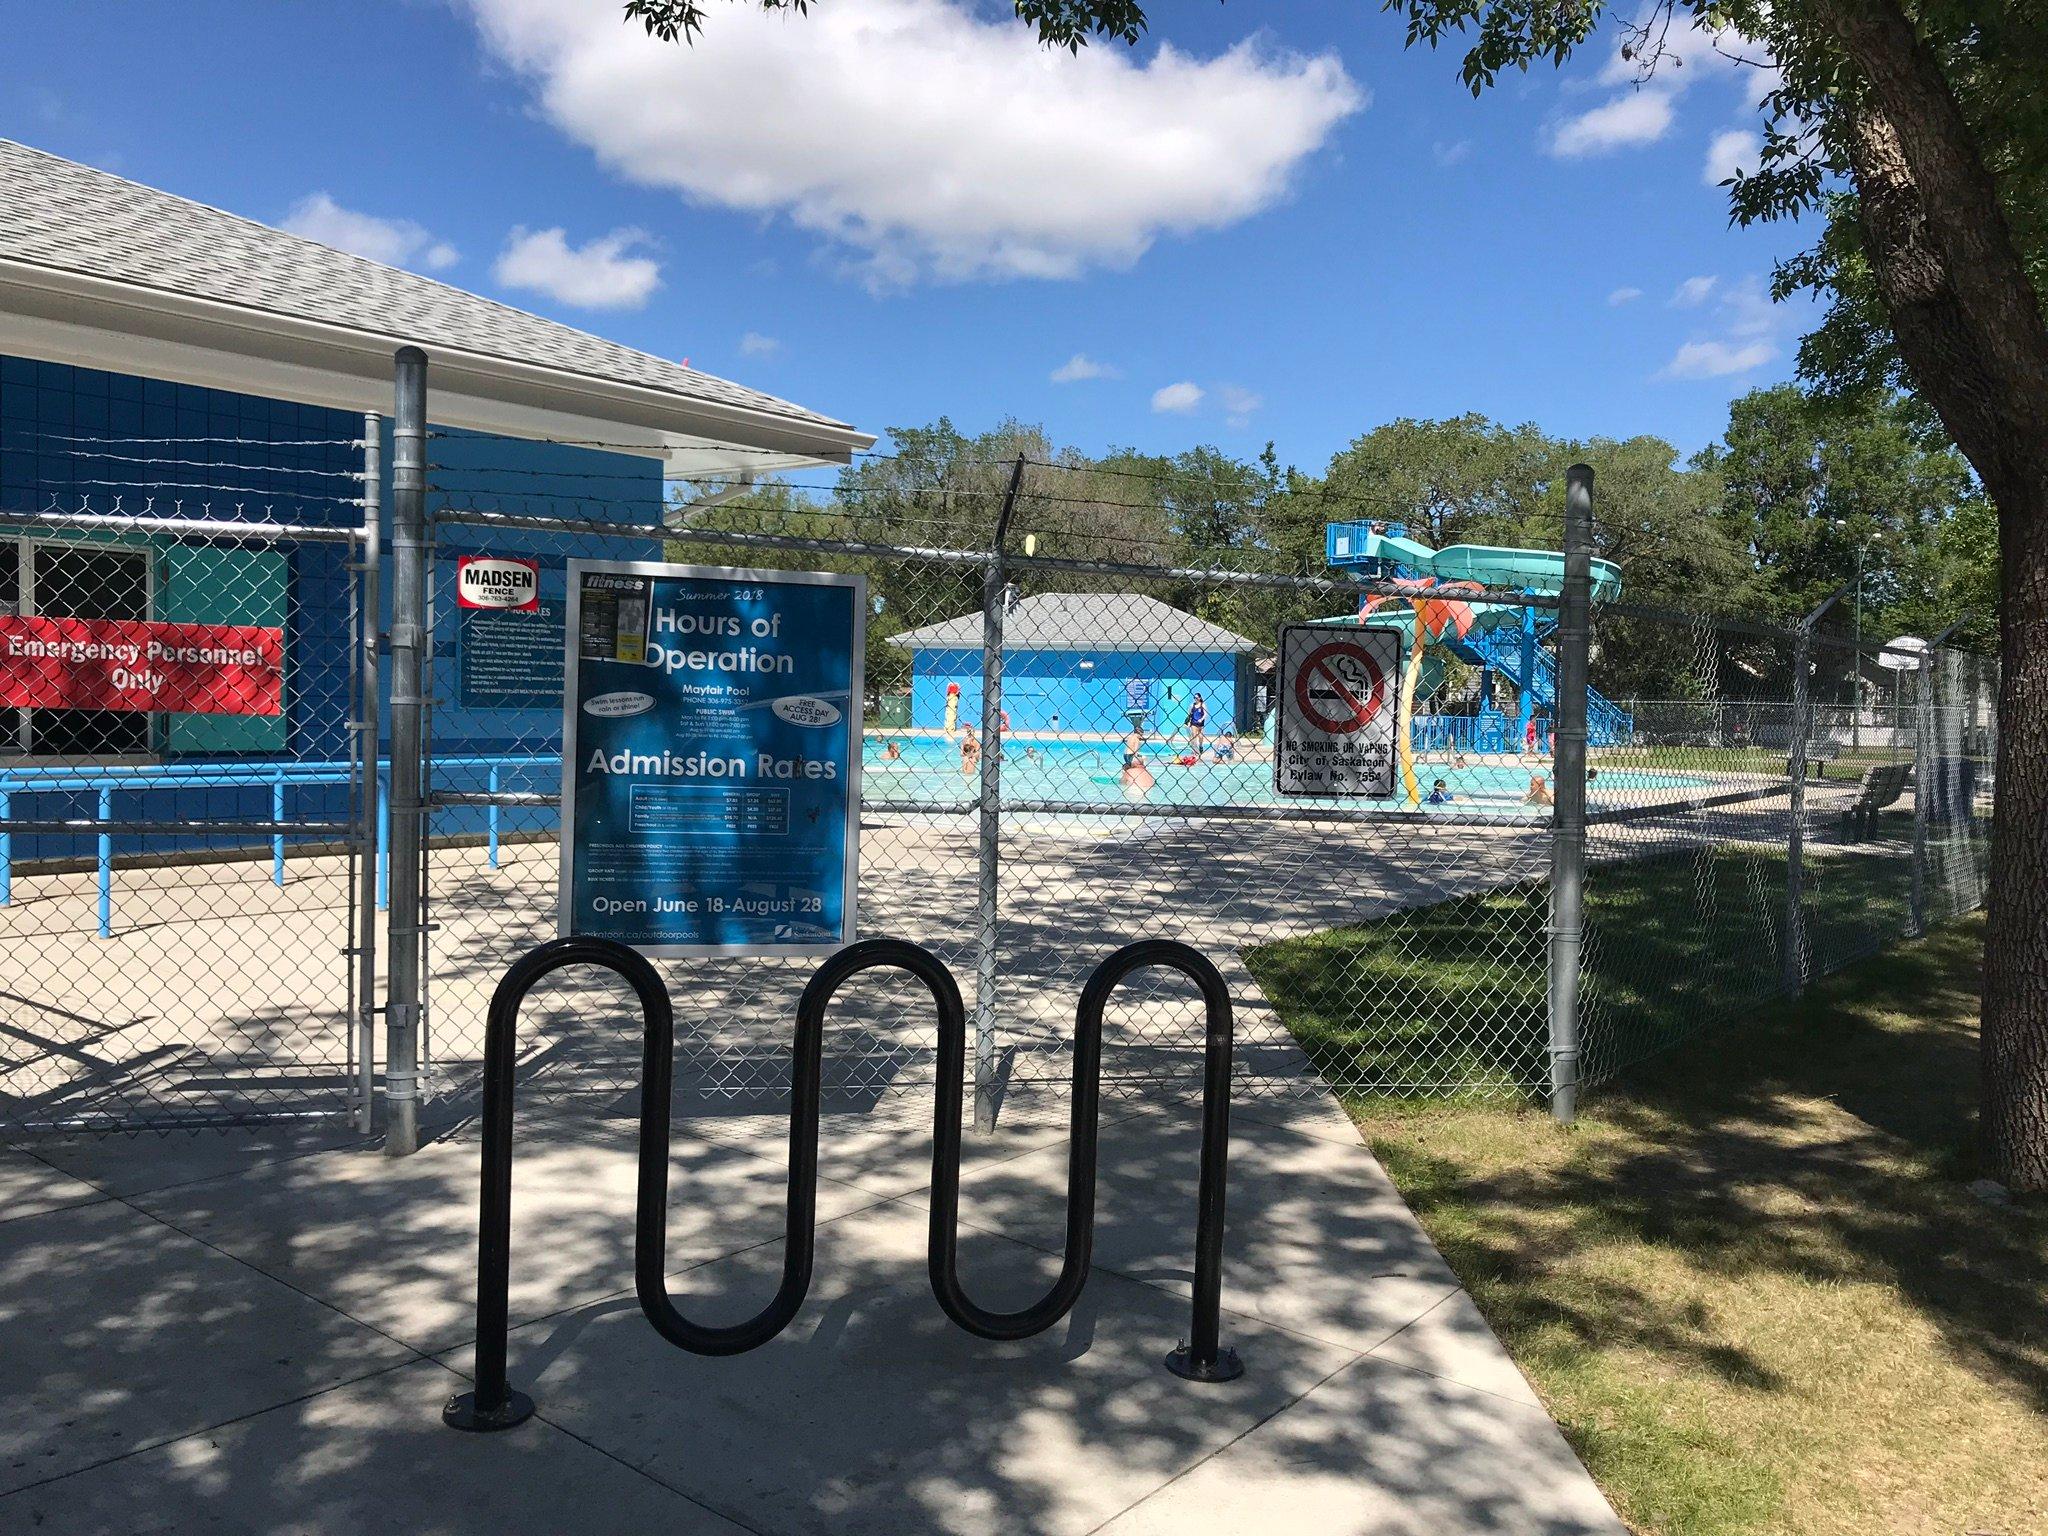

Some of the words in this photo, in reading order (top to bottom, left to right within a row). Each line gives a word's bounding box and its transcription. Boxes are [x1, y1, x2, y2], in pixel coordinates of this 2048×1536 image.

[465, 569, 532, 588] MADSEN
[587, 576, 644, 590] fitness
[676, 588, 729, 602] Summer
[734, 589, 764, 600] 2018
[656, 607, 739, 636] Hours
[750, 613, 780, 637] of
[8, 635, 140, 664] Emergency
[147, 641, 262, 666] Personnel
[644, 643, 794, 674] Operation
[112, 668, 164, 694] Only
[682, 684, 724, 696] Mayfair
[727, 686, 750, 696] Pool
[800, 699, 816, 708] FREE
[783, 705, 812, 714] ACCESS
[815, 709, 830, 717] DAY
[790, 713, 806, 721] AUG
[1286, 740, 1297, 751] NO
[1302, 741, 1338, 752] SMOKING
[1343, 742, 1354, 752] OR
[1359, 742, 1388, 754] VAPING
[586, 748, 746, 778] Admission
[758, 753, 837, 780] Rates
[1289, 754, 1309, 766] City
[1316, 755, 1327, 766] of
[1332, 756, 1385, 767] Saskatoon
[1290, 771, 1322, 781] Bylaw
[1330, 771, 1348, 781] No.
[1356, 772, 1381, 782] 7554
[592, 896, 647, 915] Open
[653, 897, 699, 913] June
[706, 896, 795, 915] 18-August
[801, 898, 822, 913] 28
